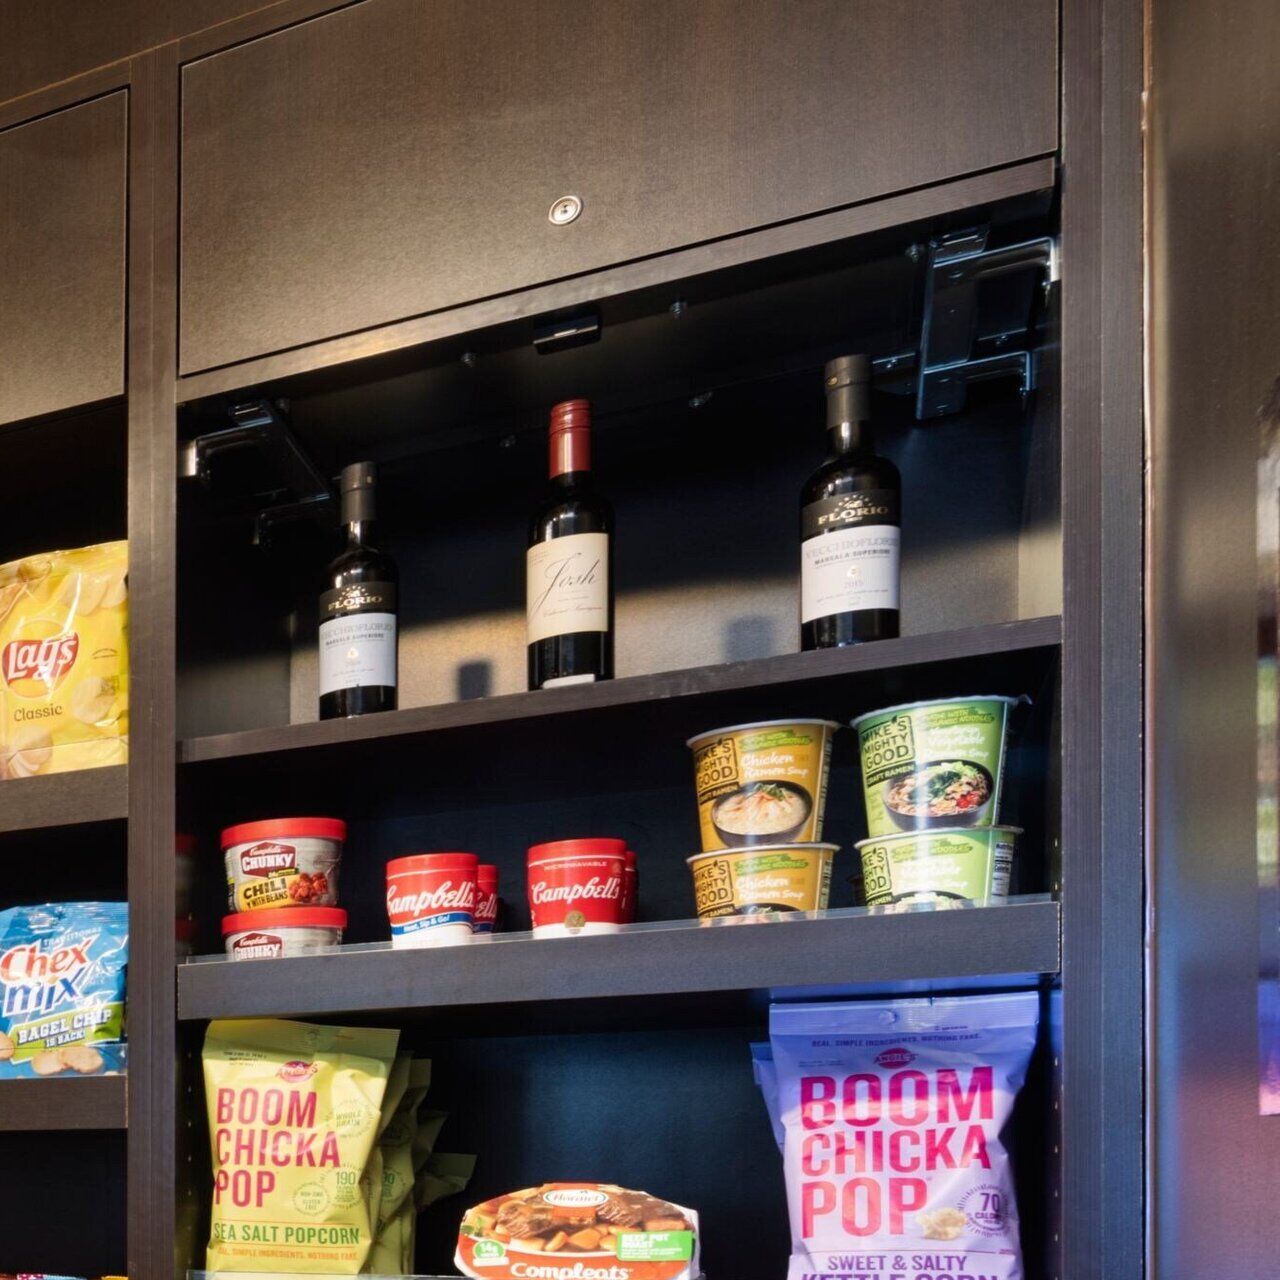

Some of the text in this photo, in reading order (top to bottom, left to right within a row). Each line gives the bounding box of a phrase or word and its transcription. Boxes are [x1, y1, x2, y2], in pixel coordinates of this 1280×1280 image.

[818, 507, 888, 524] FLORIO
[13, 703, 62, 722] Classic
[864, 733, 907, 753] MIGHTY
[742, 752, 794, 767] Chicken
[866, 746, 909, 769] GOOD
[242, 853, 294, 871] CHUNKY
[243, 878, 287, 900] CHILI
[531, 876, 621, 905] Campbell's
[737, 877, 789, 890] Chicken
[266, 890, 288, 904] BEANS
[0, 937, 96, 982] Chex
[5, 967, 85, 1014] mix
[18, 1009, 113, 1044] BAGEL CHIP
[58, 1031, 85, 1044] BACK!
[216, 1087, 317, 1128] BOOM
[800, 1066, 993, 1130] BOOM
[216, 1129, 340, 1168] CHICKA
[801, 1124, 991, 1177] CHICKA
[214, 1170, 276, 1208] POP
[336, 1171, 357, 1185] 190
[801, 1177, 927, 1238] POP
[980, 1192, 1000, 1211] 70
[214, 1223, 360, 1245] SEA SALT POPCORN
[828, 1255, 968, 1271] SWEET & SALTY
